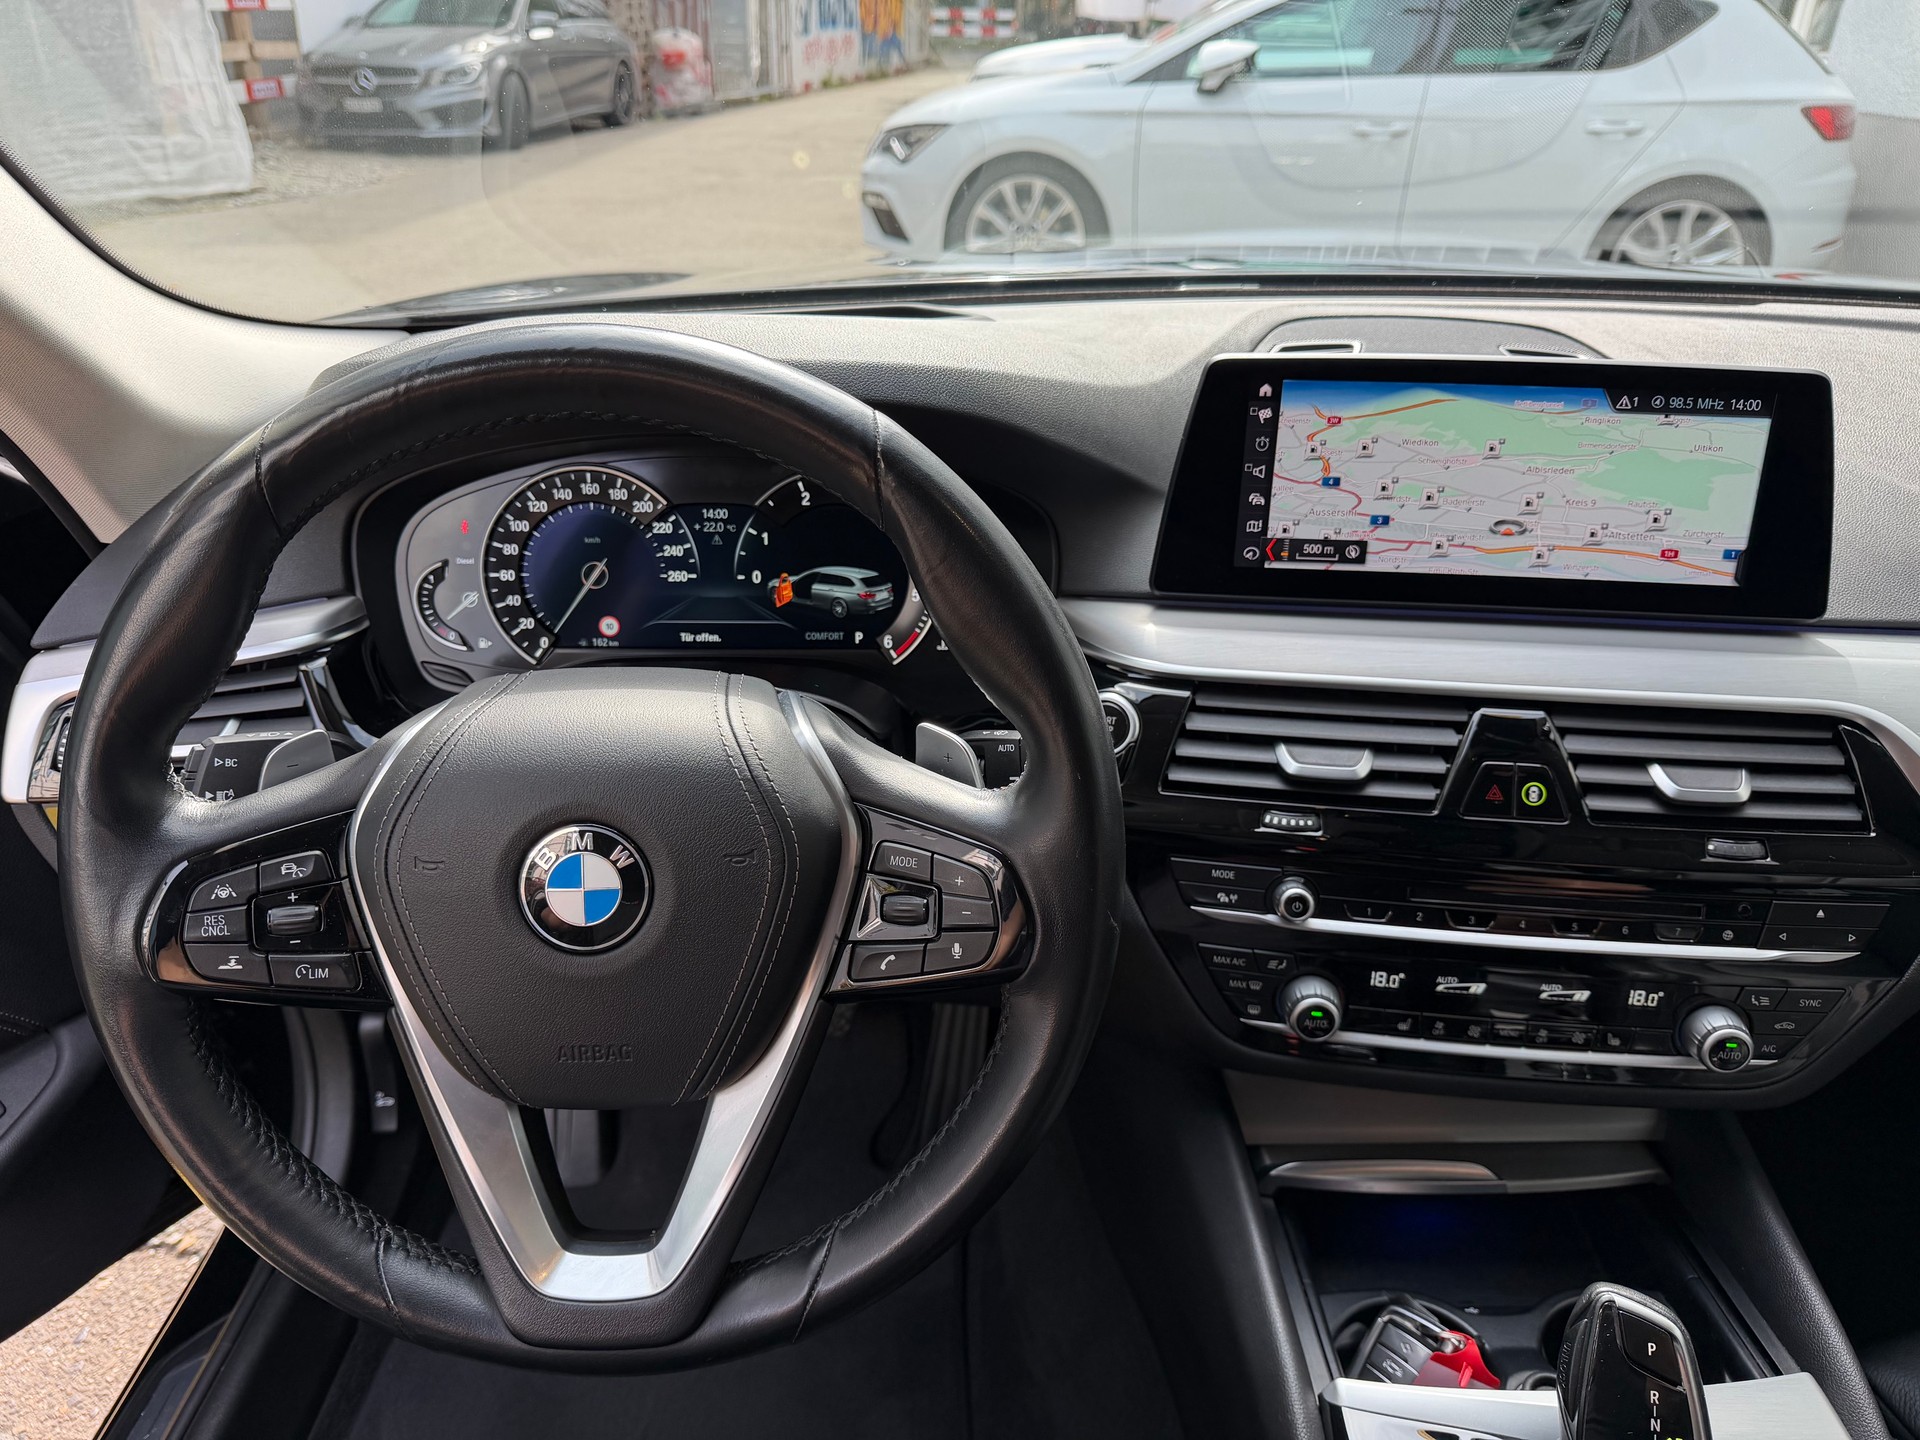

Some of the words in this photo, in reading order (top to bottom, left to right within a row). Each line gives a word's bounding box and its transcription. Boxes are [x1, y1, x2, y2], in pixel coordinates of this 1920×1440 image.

[1632, 397, 1639, 407] 1
[1669, 397, 1693, 408] 98.5
[1697, 398, 1724, 410] MHz
[1729, 399, 1761, 411] 14:00
[1584, 417, 1621, 426] Ringlikon
[1401, 439, 1439, 447] Wiedikon
[1525, 466, 1575, 475] Albisrieden
[552, 488, 573, 501] 140
[580, 483, 600, 496] 160
[608, 489, 628, 501] 180
[801, 492, 811, 506] 2
[1565, 500, 1589, 508] Kreis
[1591, 499, 1597, 508] 9
[527, 501, 548, 513] 120
[633, 501, 654, 514] 200
[1308, 508, 1357, 517] Aussersihl
[702, 508, 728, 519] 14:00
[509, 520, 530, 533] 100
[652, 522, 673, 534] 220
[703, 522, 724, 533] 22.0
[584, 536, 601, 544] km/h
[761, 532, 768, 545] 1
[1608, 532, 1656, 541] Altstetten
[502, 544, 519, 556] 80
[663, 545, 684, 557] 240
[1302, 544, 1322, 554] 500
[1324, 546, 1334, 554] m
[456, 557, 475, 565] Diesel
[499, 570, 516, 582] 60
[667, 570, 688, 582] 260
[752, 570, 762, 583] 0
[506, 595, 521, 607] 40
[519, 618, 535, 630] 20
[605, 622, 615, 631] 10
[680, 632, 695, 643] Tür
[696, 632, 722, 643] offen.
[805, 632, 844, 641] COMFORT
[854, 632, 863, 644] P
[883, 635, 893, 648] 6
[539, 637, 549, 649] 0
[592, 638, 608, 647] 162
[608, 639, 620, 647] km
[998, 744, 1015, 752] AUTO
[225, 758, 238, 768] BC
[534, 832, 636, 871] BMW
[889, 855, 918, 869] MODE
[1211, 869, 1236, 880] MODE
[1366, 908, 1372, 916] 1
[1416, 912, 1423, 922] 2
[204, 915, 225, 926] RES
[1469, 916, 1476, 925] 3
[1519, 919, 1526, 929] 4
[201, 925, 230, 936] CNCL
[1572, 922, 1579, 931] 5
[1622, 926, 1629, 935] 6
[1675, 928, 1681, 936] 7
[1213, 955, 1231, 965] MAX
[1232, 957, 1247, 967] A/C
[309, 968, 329, 979] LIM
[1229, 979, 1247, 989] MAX
[1436, 976, 1459, 984] AUTO
[1540, 983, 1562, 991] AUTO
[1800, 999, 1822, 1007] SYNC
[1304, 1018, 1328, 1028] AUTO
[559, 1044, 633, 1063] AIRBAG
[1762, 1045, 1776, 1053] A/C
[1718, 1051, 1741, 1060] AUTO
[1647, 1342, 1657, 1356] P
[1650, 1390, 1660, 1405] R
[1650, 1418, 1661, 1432] N
